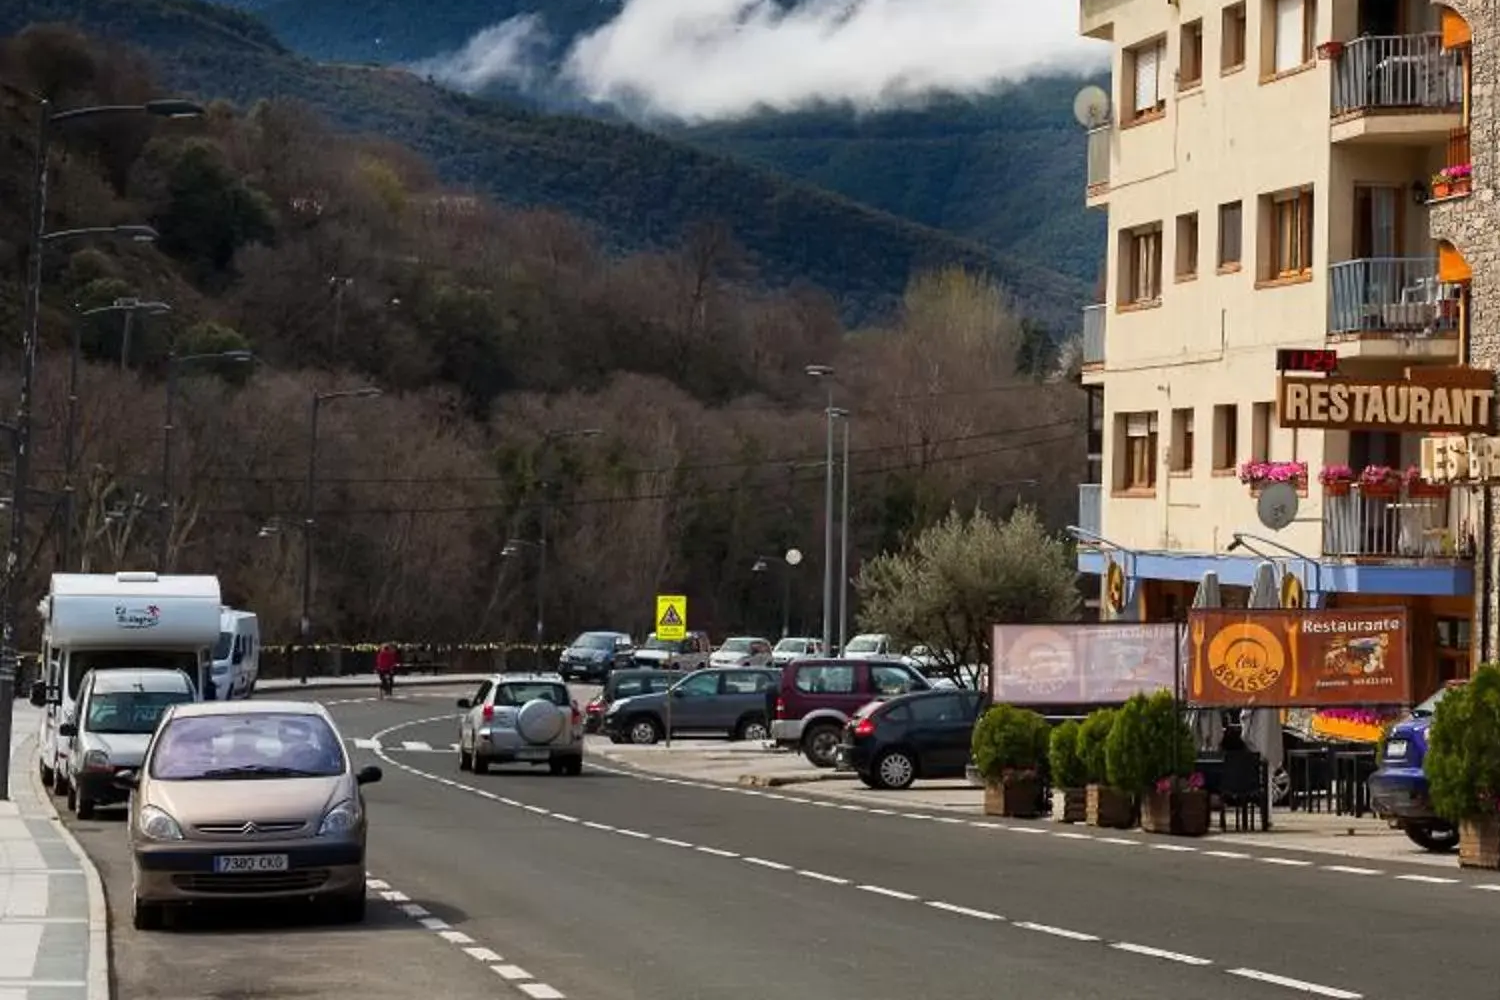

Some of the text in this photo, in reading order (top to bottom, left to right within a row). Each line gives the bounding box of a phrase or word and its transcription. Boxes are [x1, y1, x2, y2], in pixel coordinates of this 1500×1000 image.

[1285, 383, 1495, 424] RESTAURANT
[1421, 437, 1468, 482] LES
[1302, 618, 1400, 633] Restaurante
[1213, 663, 1279, 691] BRASES
